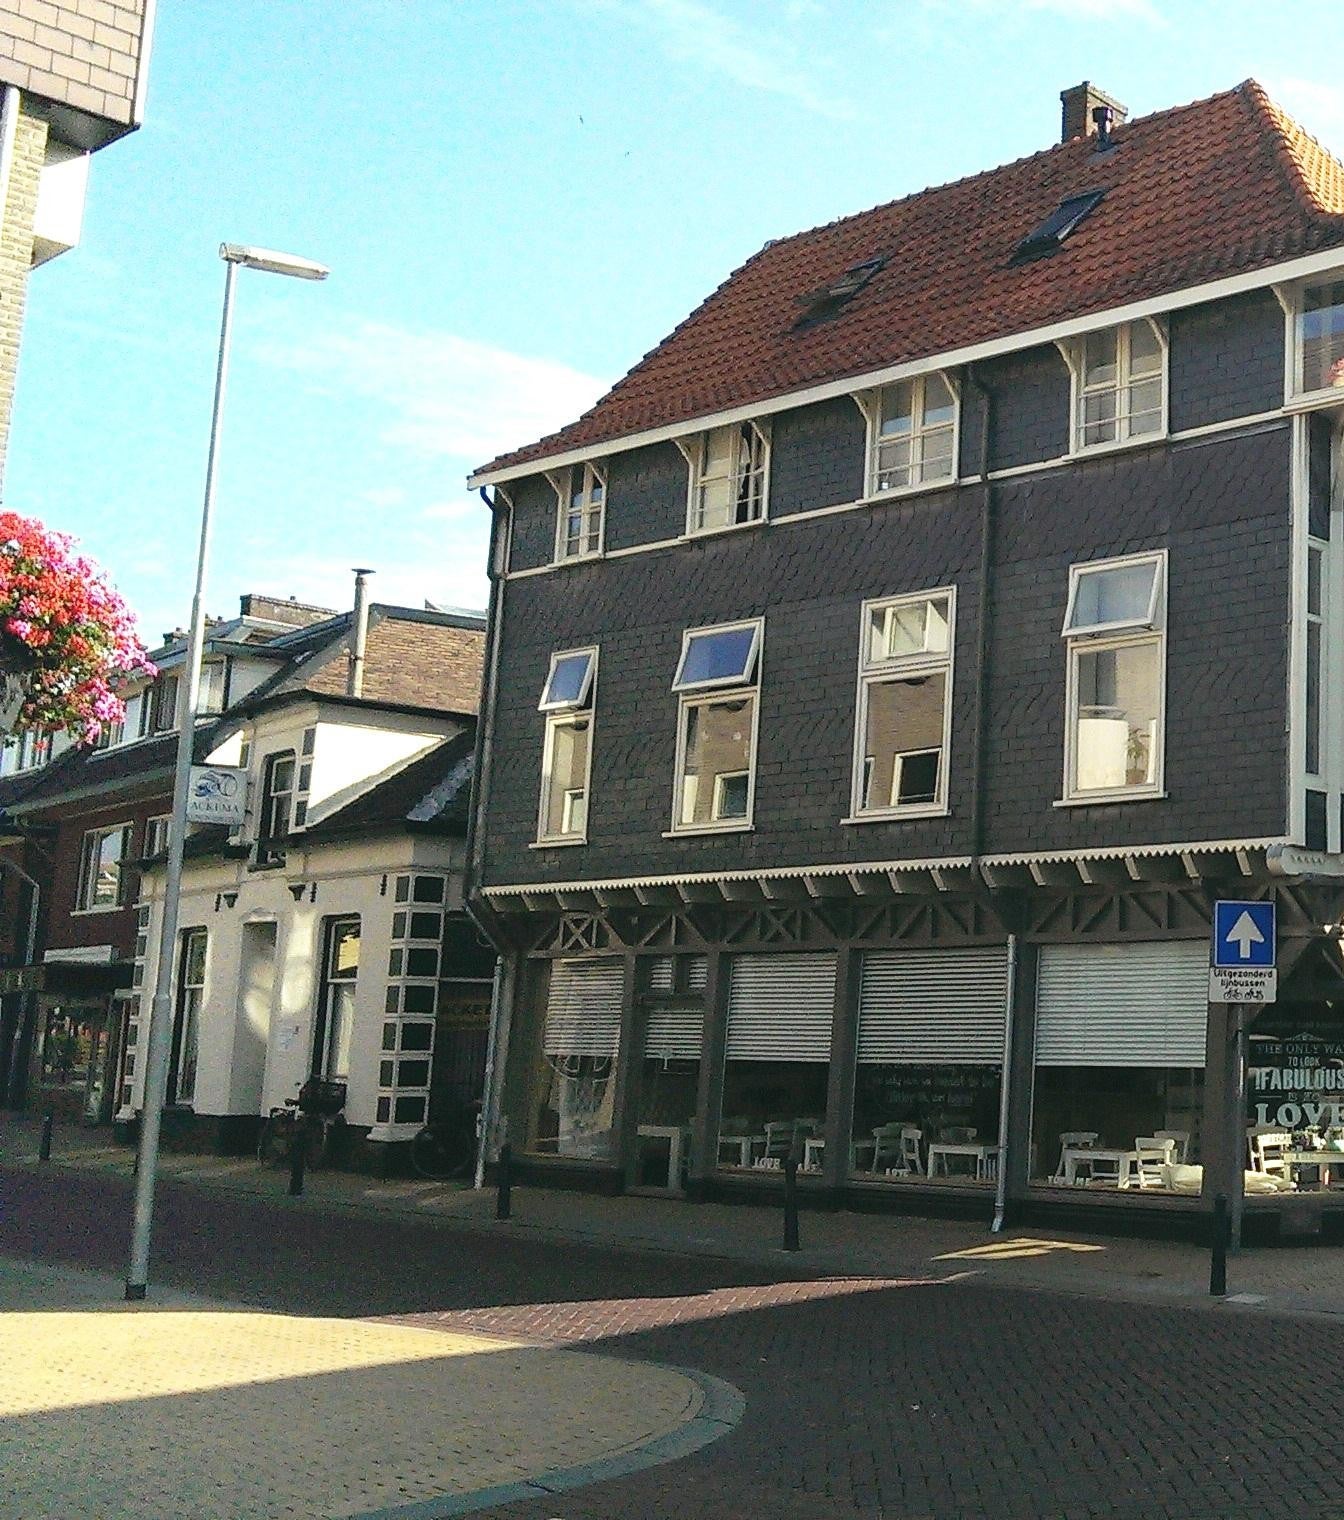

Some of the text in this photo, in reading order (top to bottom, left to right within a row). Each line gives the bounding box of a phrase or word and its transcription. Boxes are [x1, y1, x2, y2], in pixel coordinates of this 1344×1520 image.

[1213, 969, 1273, 979] Uitgezonderd
[1220, 980, 1265, 989] lijnbussen
[1256, 1044, 1282, 1054] THE
[1286, 1044, 1319, 1054] ONLY
[1288, 1056, 1321, 1067] TO LOOK
